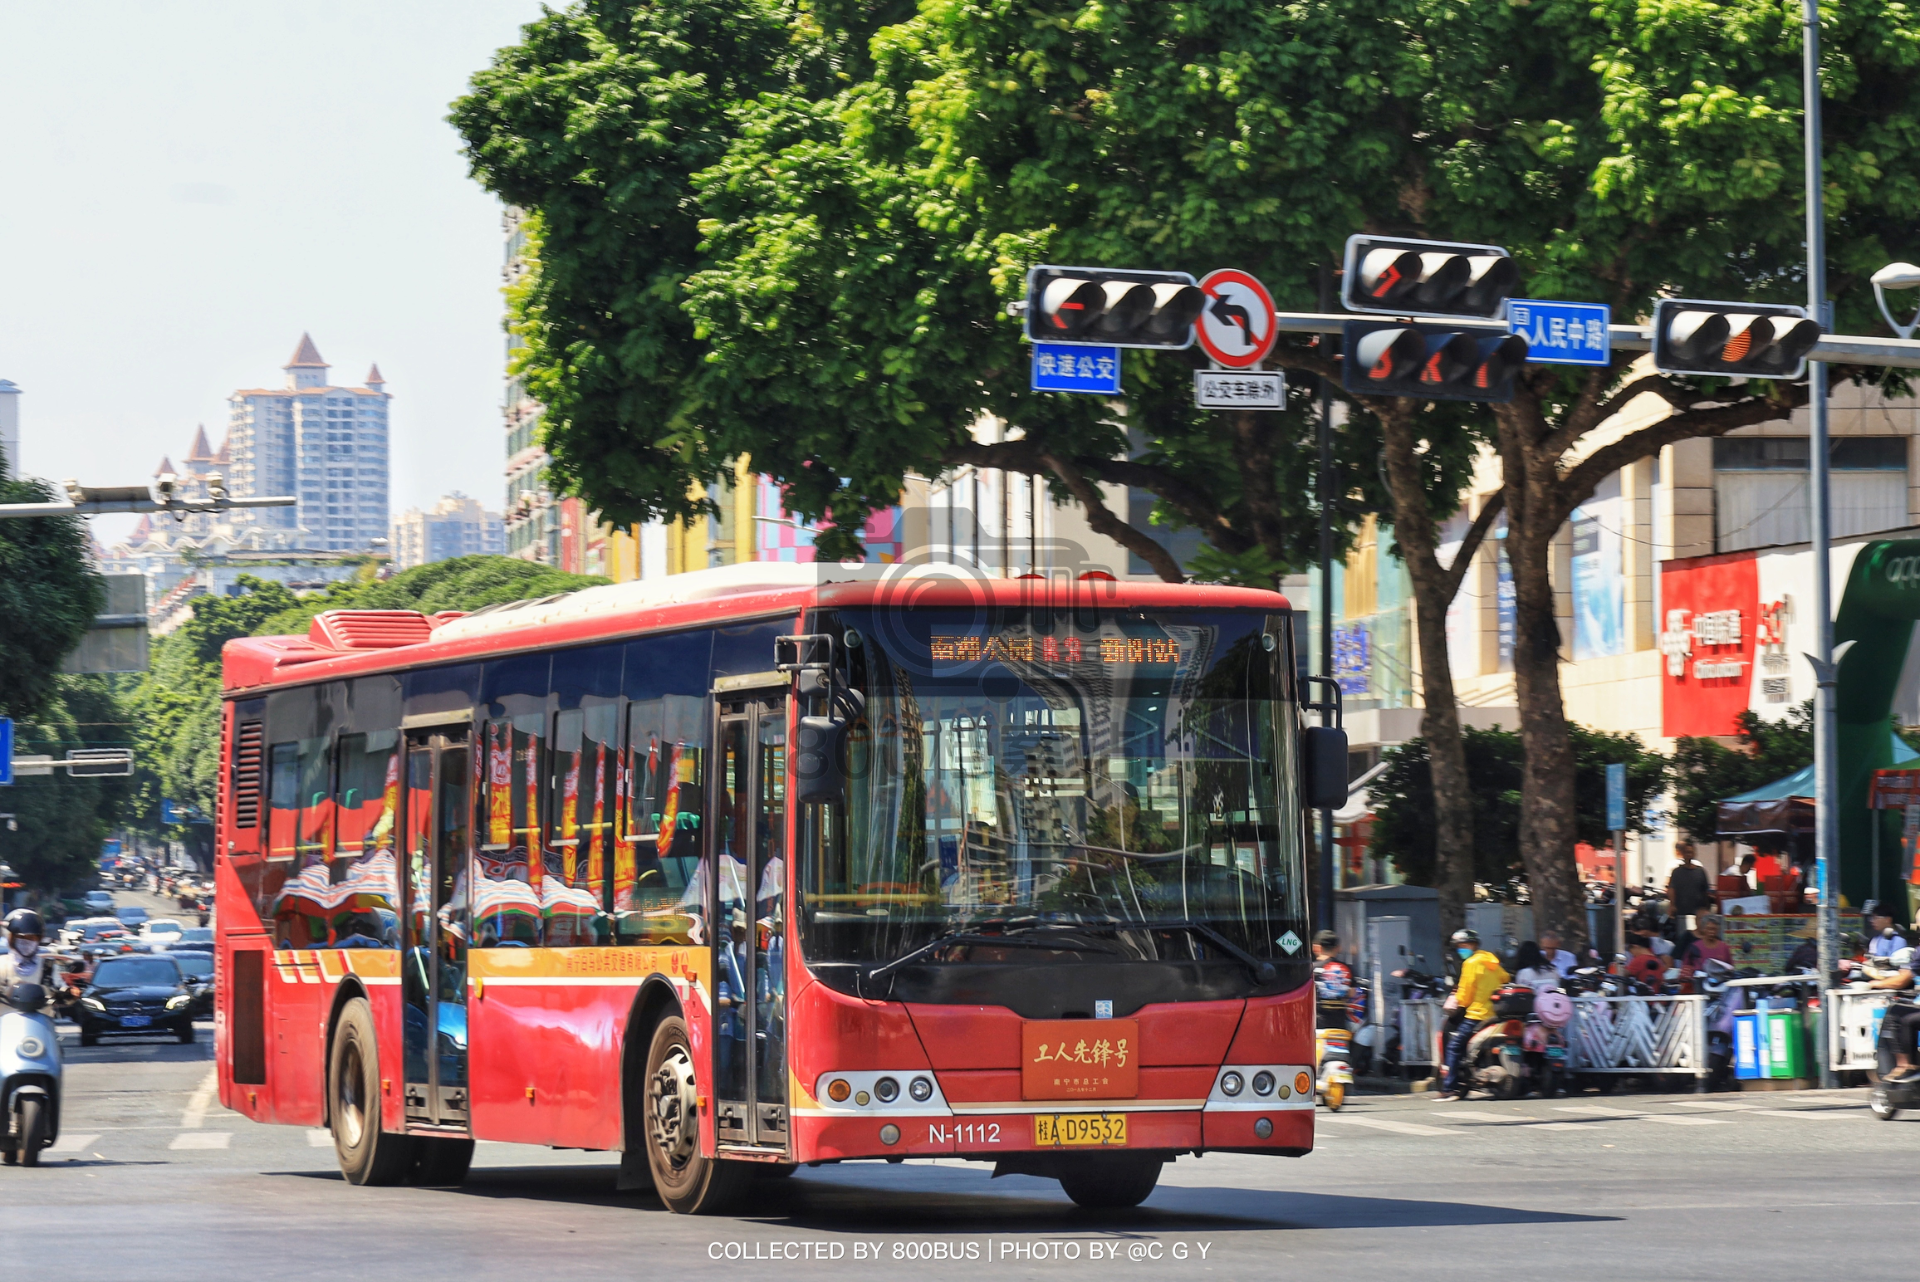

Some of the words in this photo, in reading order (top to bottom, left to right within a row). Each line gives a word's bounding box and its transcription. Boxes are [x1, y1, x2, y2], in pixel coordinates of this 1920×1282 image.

[1531, 315, 1603, 351] 人民中路
[1038, 352, 1114, 380] 快速公交
[1202, 380, 1276, 400] 公交车除外
[1281, 938, 1298, 947] LNG
[1053, 1078, 1109, 1086] 南宁市总工会
[928, 1123, 1001, 1144] N-1112
